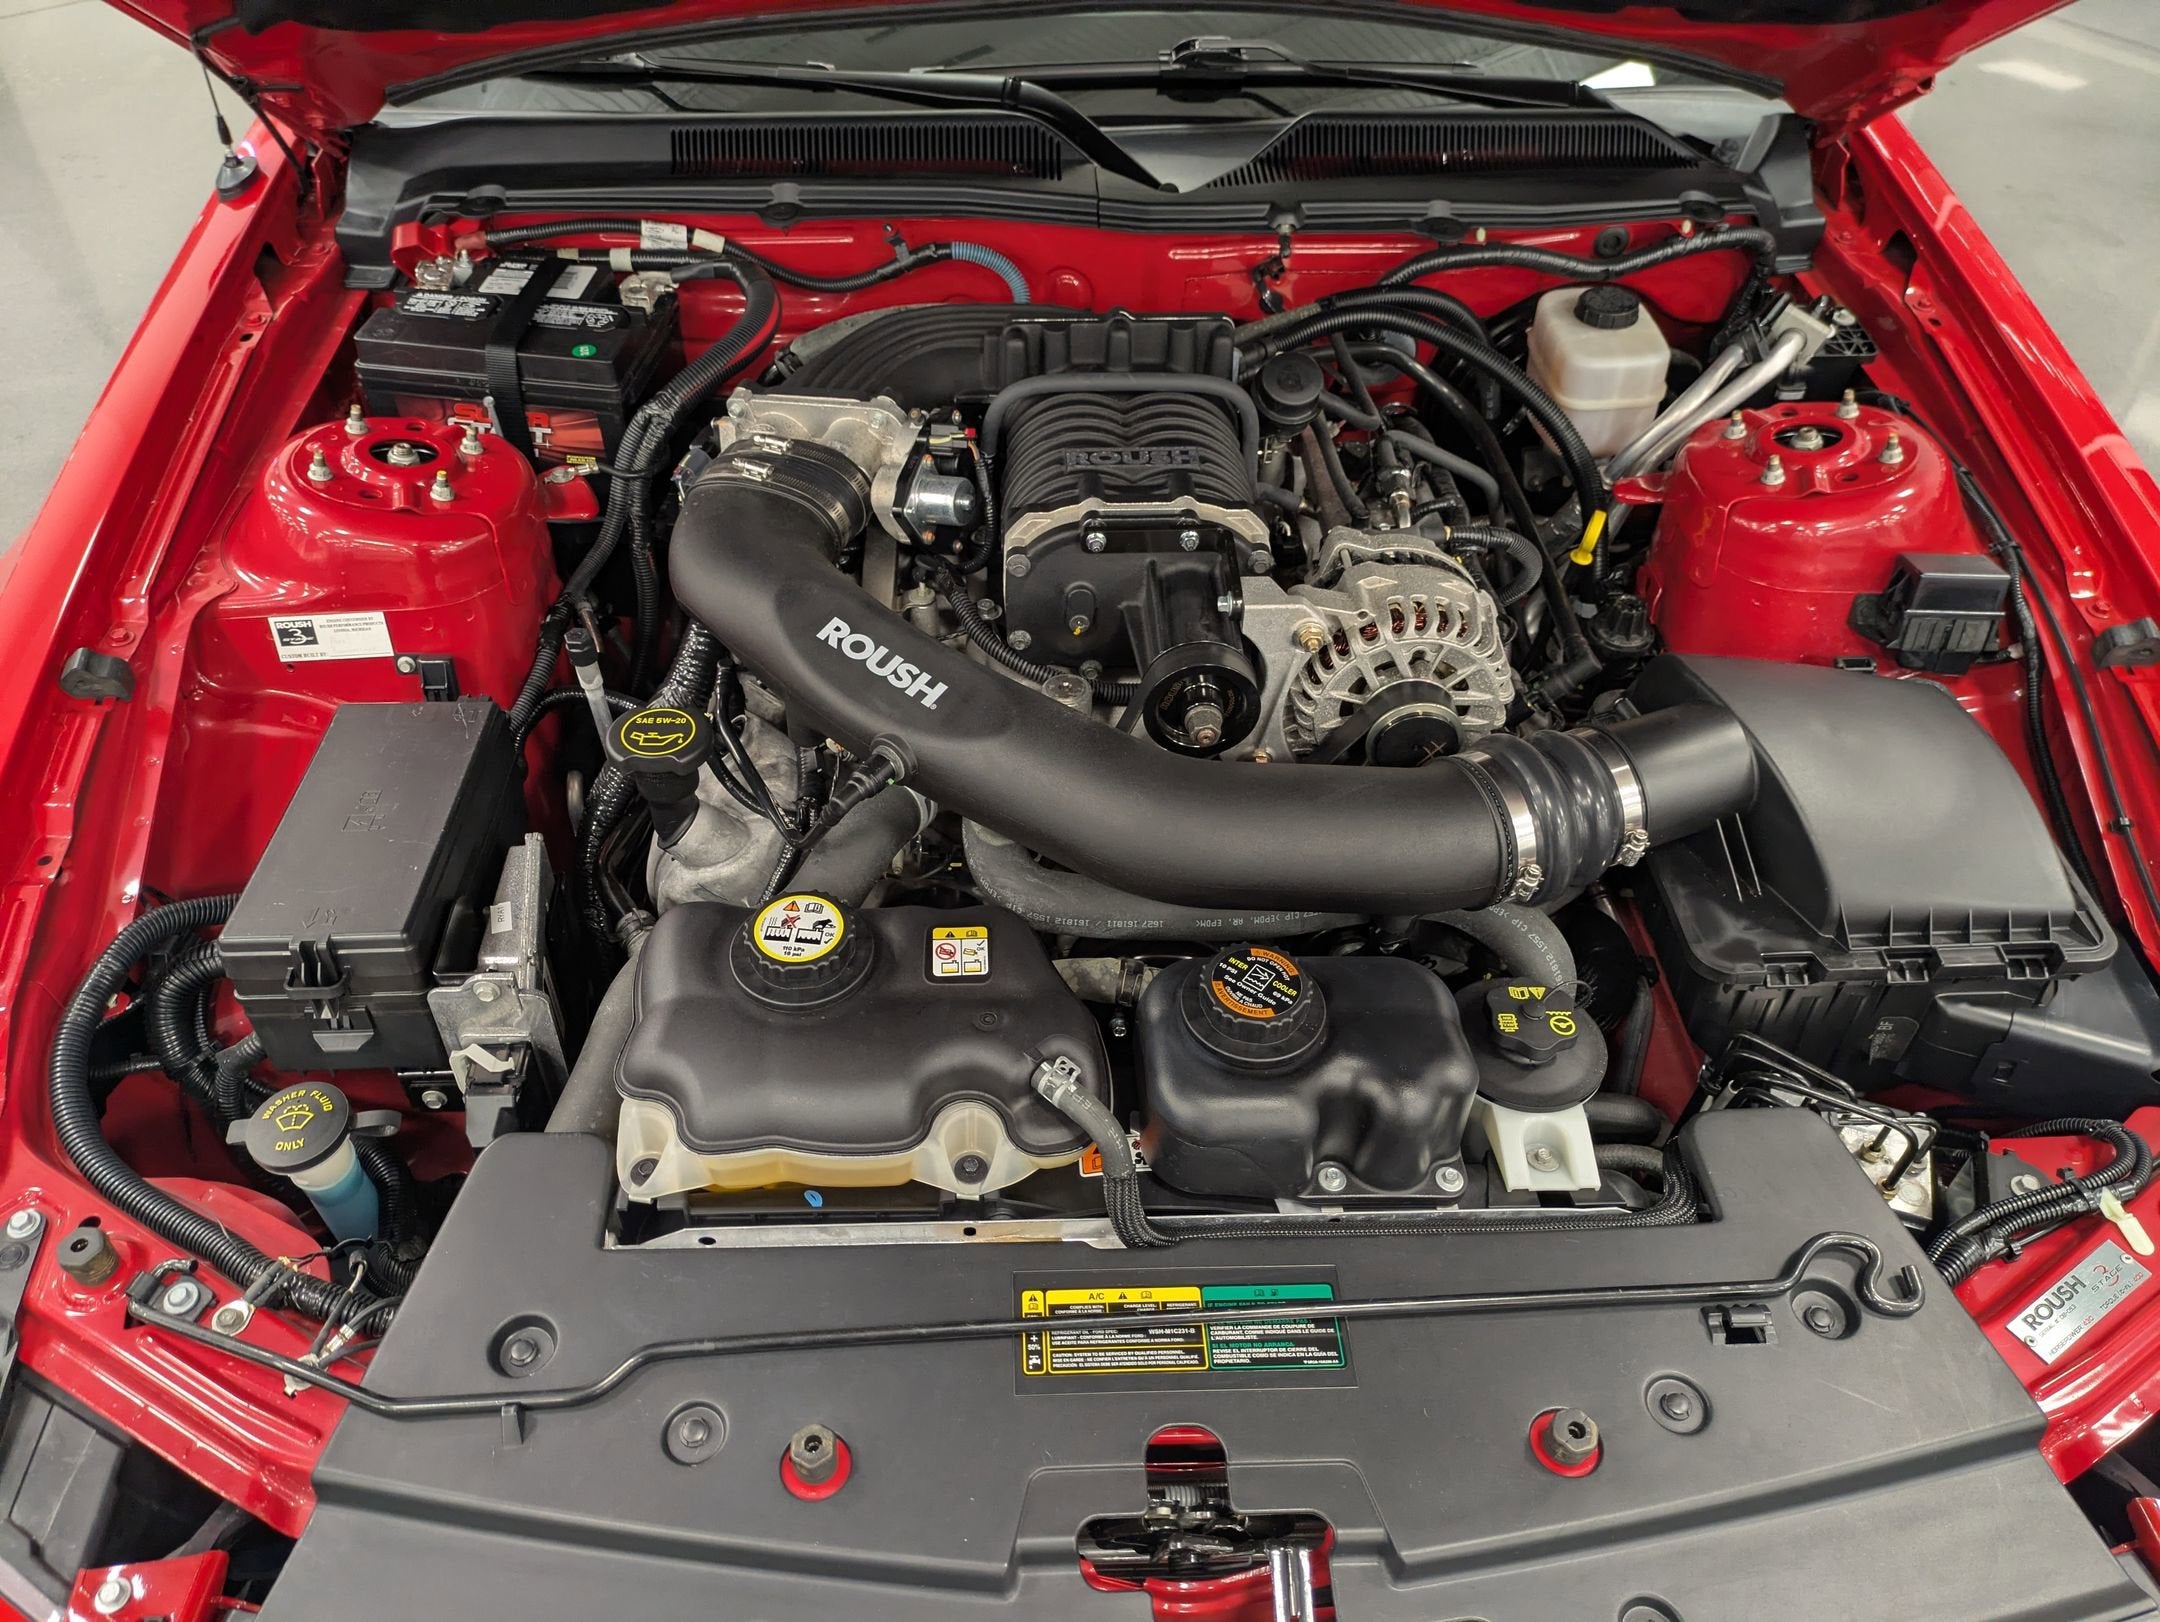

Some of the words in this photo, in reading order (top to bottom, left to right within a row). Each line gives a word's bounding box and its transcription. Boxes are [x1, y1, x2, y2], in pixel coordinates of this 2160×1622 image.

[1066, 450, 1200, 465] ROUSH
[275, 621, 312, 629] ROUSH
[816, 616, 949, 708] ROUSH
[1511, 919, 1528, 932] CIP
[1228, 956, 1249, 970] INTER
[1262, 951, 1294, 973] WARNING
[1269, 961, 1284, 972] OPEN
[1226, 966, 1238, 974] PSI
[1223, 974, 1236, 984] See
[1237, 981, 1257, 995] Owner
[1257, 993, 1276, 1006] Guide
[1272, 980, 1297, 997] COOLER
[262, 1089, 307, 1121] WASHER
[310, 1090, 334, 1112] FLUID
[275, 1138, 305, 1151] ONLY
[2091, 1264, 2122, 1293] STAGE
[1088, 1292, 1105, 1300] A/C
[2021, 1274, 2087, 1331] ROUSH
